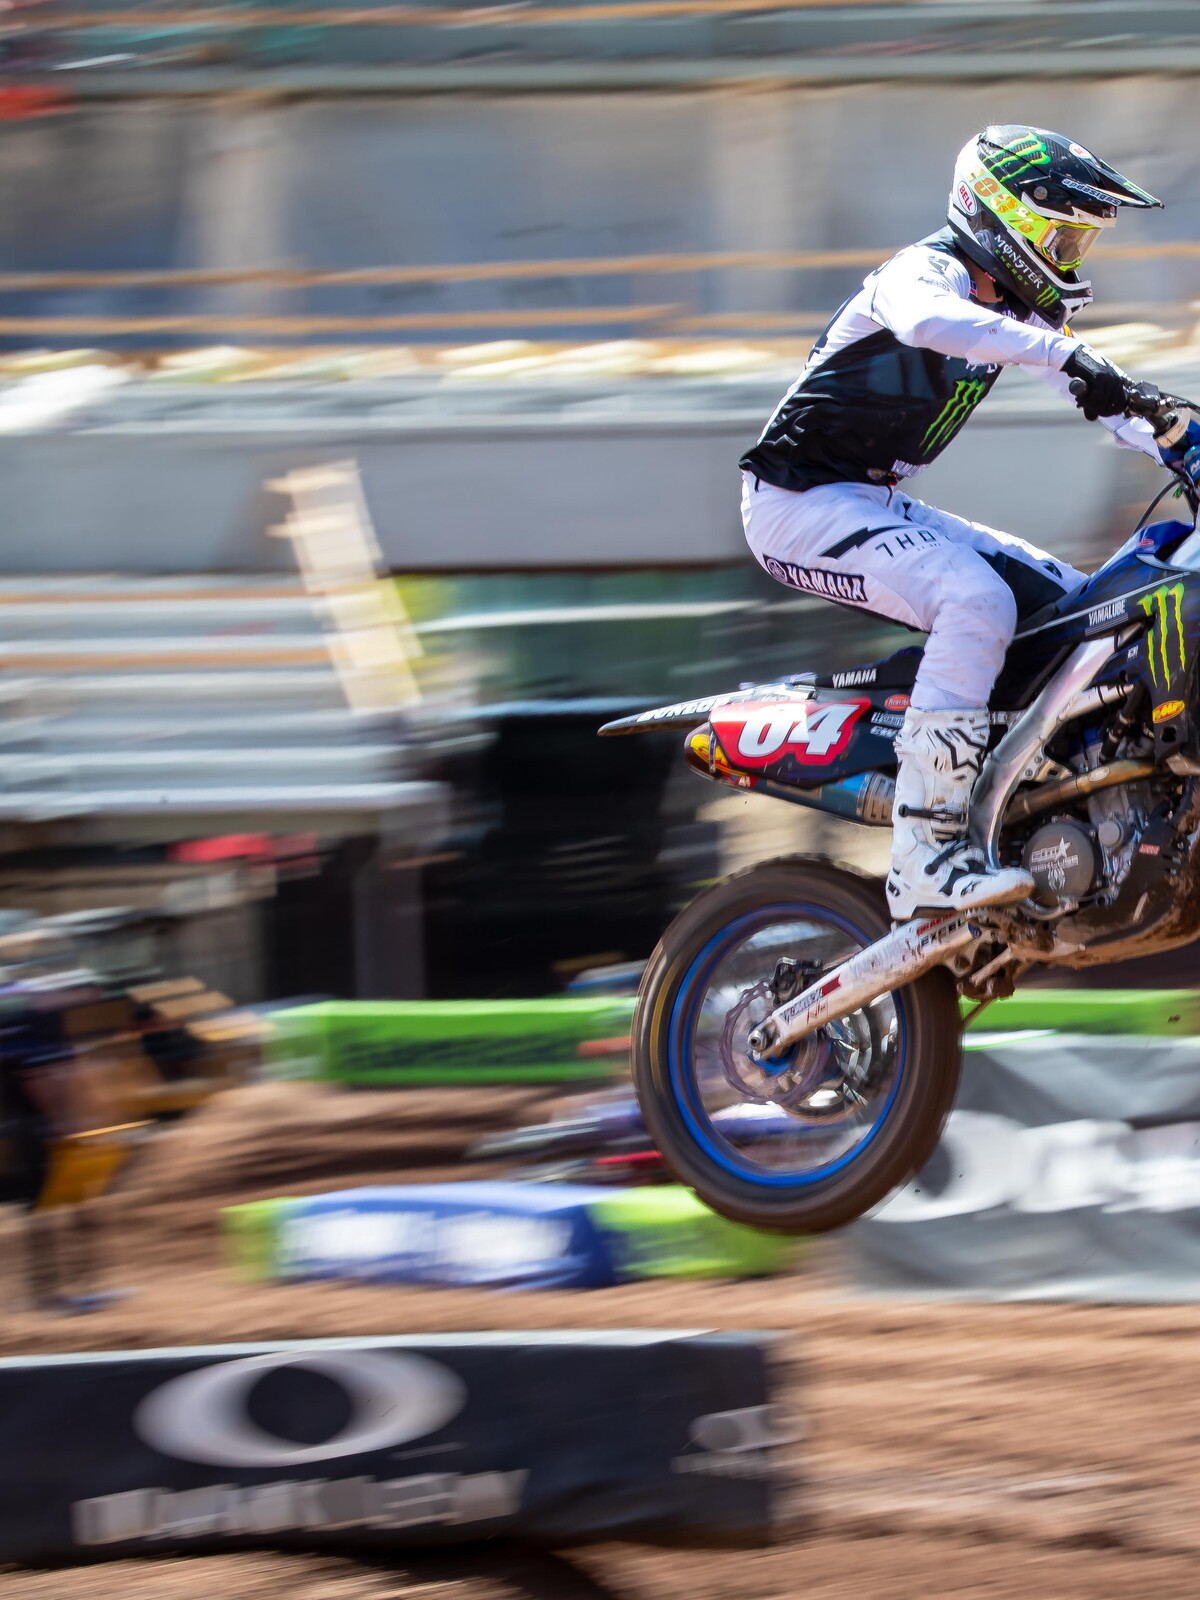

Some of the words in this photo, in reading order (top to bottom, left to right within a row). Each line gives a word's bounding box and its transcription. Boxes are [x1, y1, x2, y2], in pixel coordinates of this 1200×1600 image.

[958, 183, 974, 212] BELL
[994, 234, 1044, 289] MONSTER
[994, 248, 1029, 286] ENERGY
[785, 563, 869, 601] YAMAHA
[1088, 599, 1127, 627] YAMALUBE
[832, 667, 877, 689] YAMAHA
